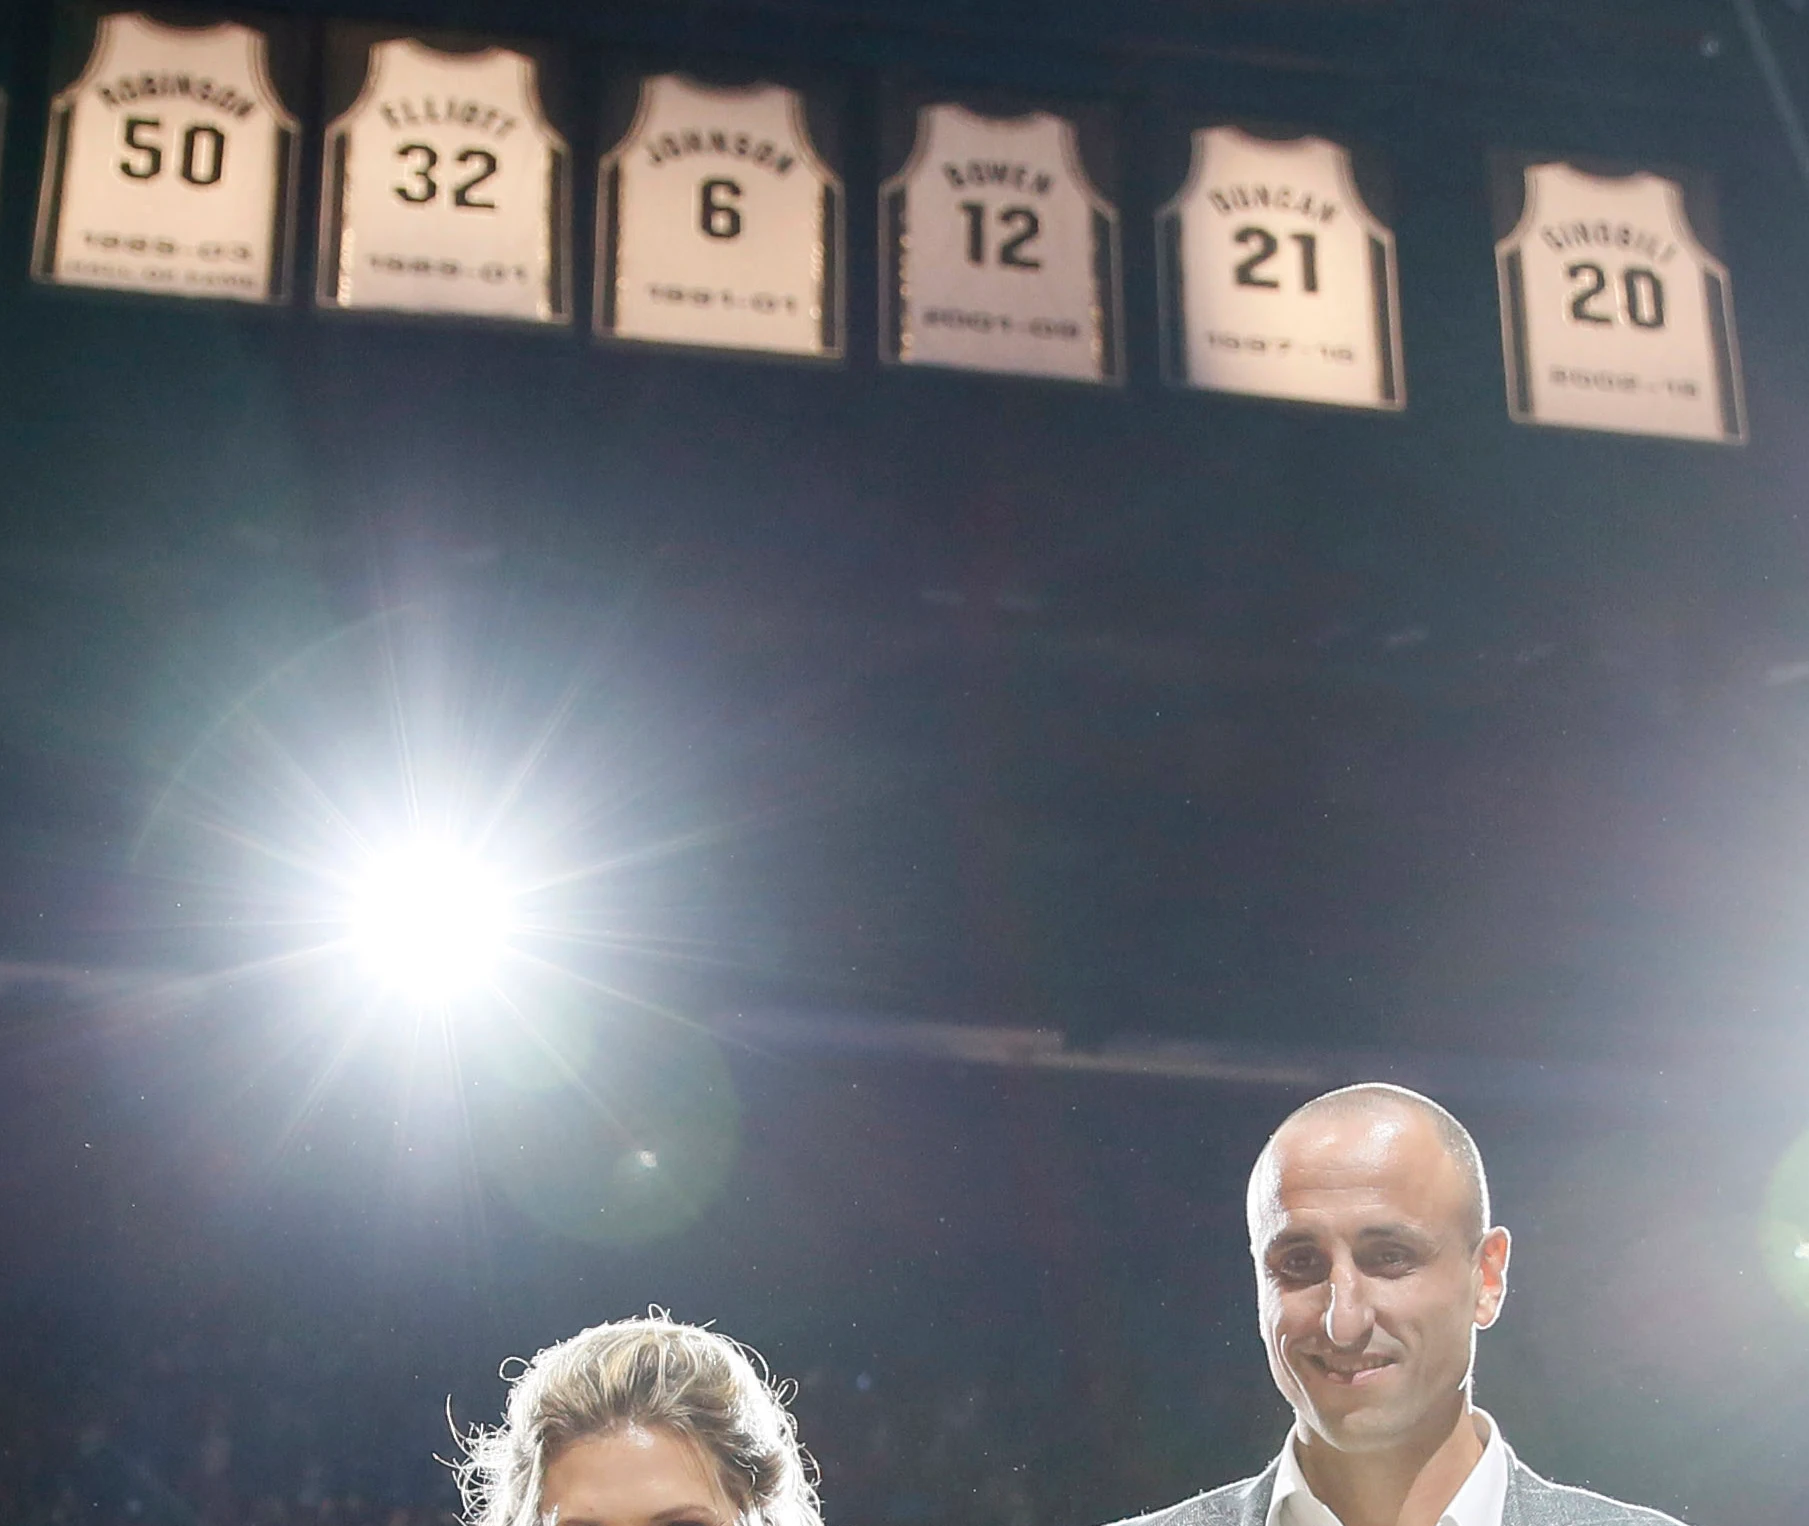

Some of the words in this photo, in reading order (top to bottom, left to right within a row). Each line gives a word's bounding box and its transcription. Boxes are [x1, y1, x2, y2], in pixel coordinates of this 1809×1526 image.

[381, 97, 514, 134] ELLIOTT
[119, 118, 224, 185] 50
[396, 144, 497, 208] 32
[700, 179, 742, 238] 6
[961, 202, 1041, 269] 12
[1209, 185, 1336, 223] DUNCAN
[1234, 226, 1319, 293] 21
[1542, 222, 1677, 264] GINOBILI
[1567, 263, 1666, 328] 20
